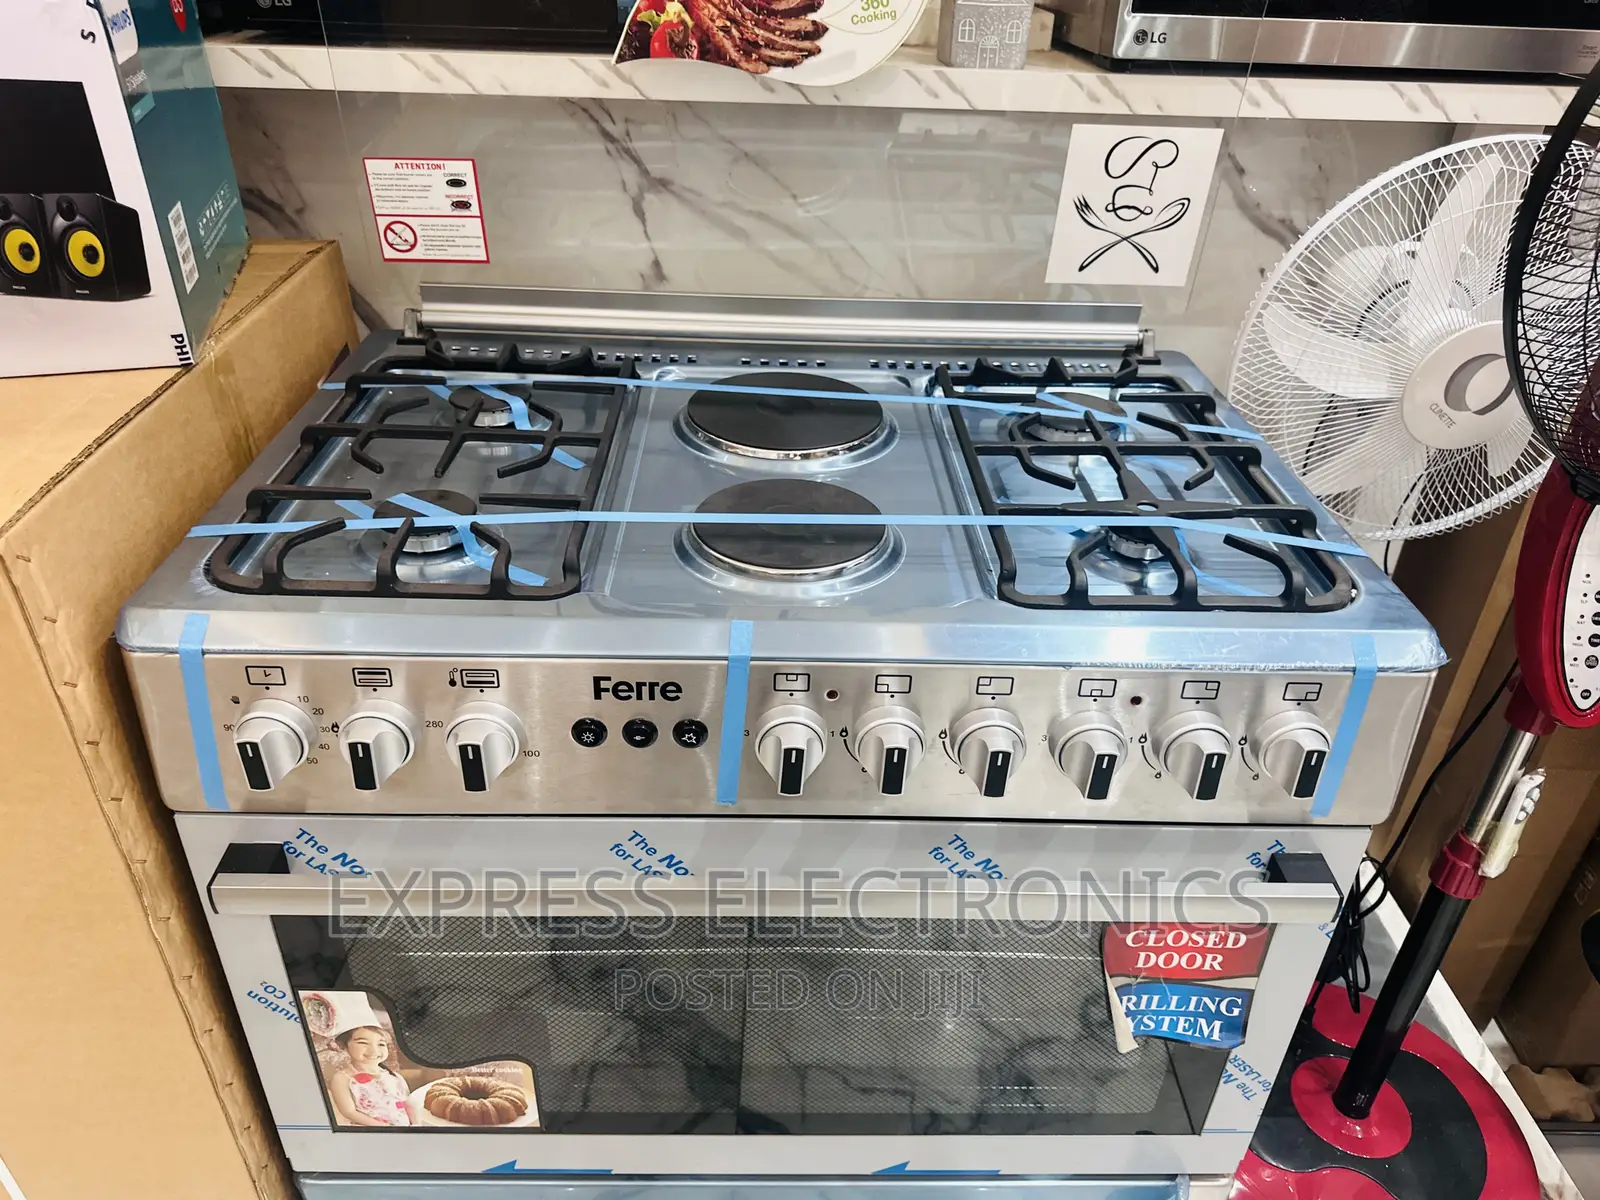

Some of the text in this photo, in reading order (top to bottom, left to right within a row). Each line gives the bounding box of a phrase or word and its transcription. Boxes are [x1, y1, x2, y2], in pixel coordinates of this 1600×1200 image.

[851, 10, 897, 25] Cooking
[1150, 32, 1167, 43] LG
[394, 162, 446, 170] ATTENTION!
[593, 676, 683, 701] Ferre
[297, 695, 309, 703] 10
[312, 707, 324, 715] 20
[425, 720, 444, 729] 280
[1041, 734, 1048, 742] 3
[306, 757, 318, 765] 50
[522, 749, 541, 758] 100
[296, 828, 372, 876] The No
[609, 843, 634, 860] for
[628, 830, 695, 876] The No
[928, 846, 951, 864] for
[948, 833, 1008, 880] The No
[1246, 852, 1267, 869] for
[1125, 930, 1247, 949] CLOSED
[1135, 951, 1224, 971] DOOR
[1228, 1055, 1262, 1081] LASER
[1236, 1082, 1257, 1101] The
